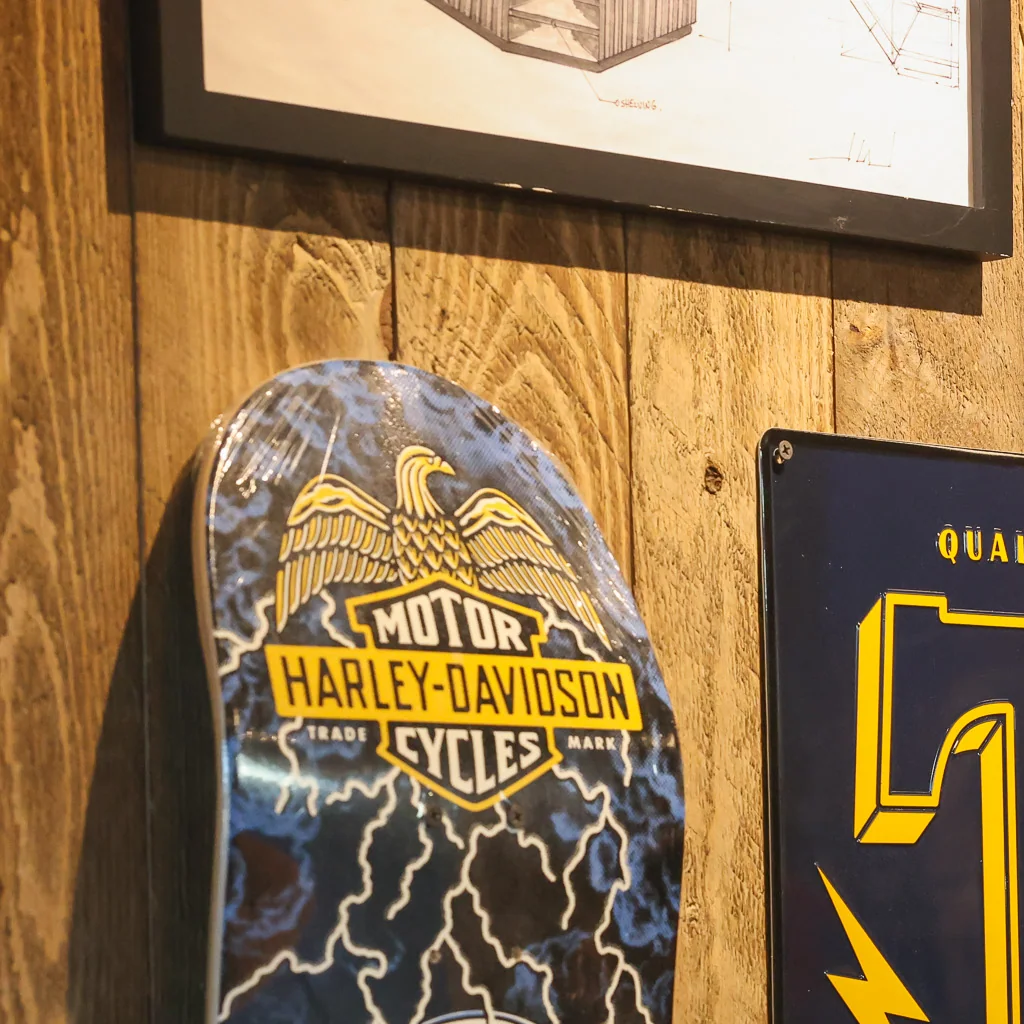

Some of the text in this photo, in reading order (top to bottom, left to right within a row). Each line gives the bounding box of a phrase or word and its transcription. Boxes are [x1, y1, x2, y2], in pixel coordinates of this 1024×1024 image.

[372, 588, 528, 652] MOTOR
[281, 655, 631, 721] HARLEY-DAVIDSON
[306, 724, 618, 752] TRADE MARK
[395, 727, 542, 796] CYCLES
